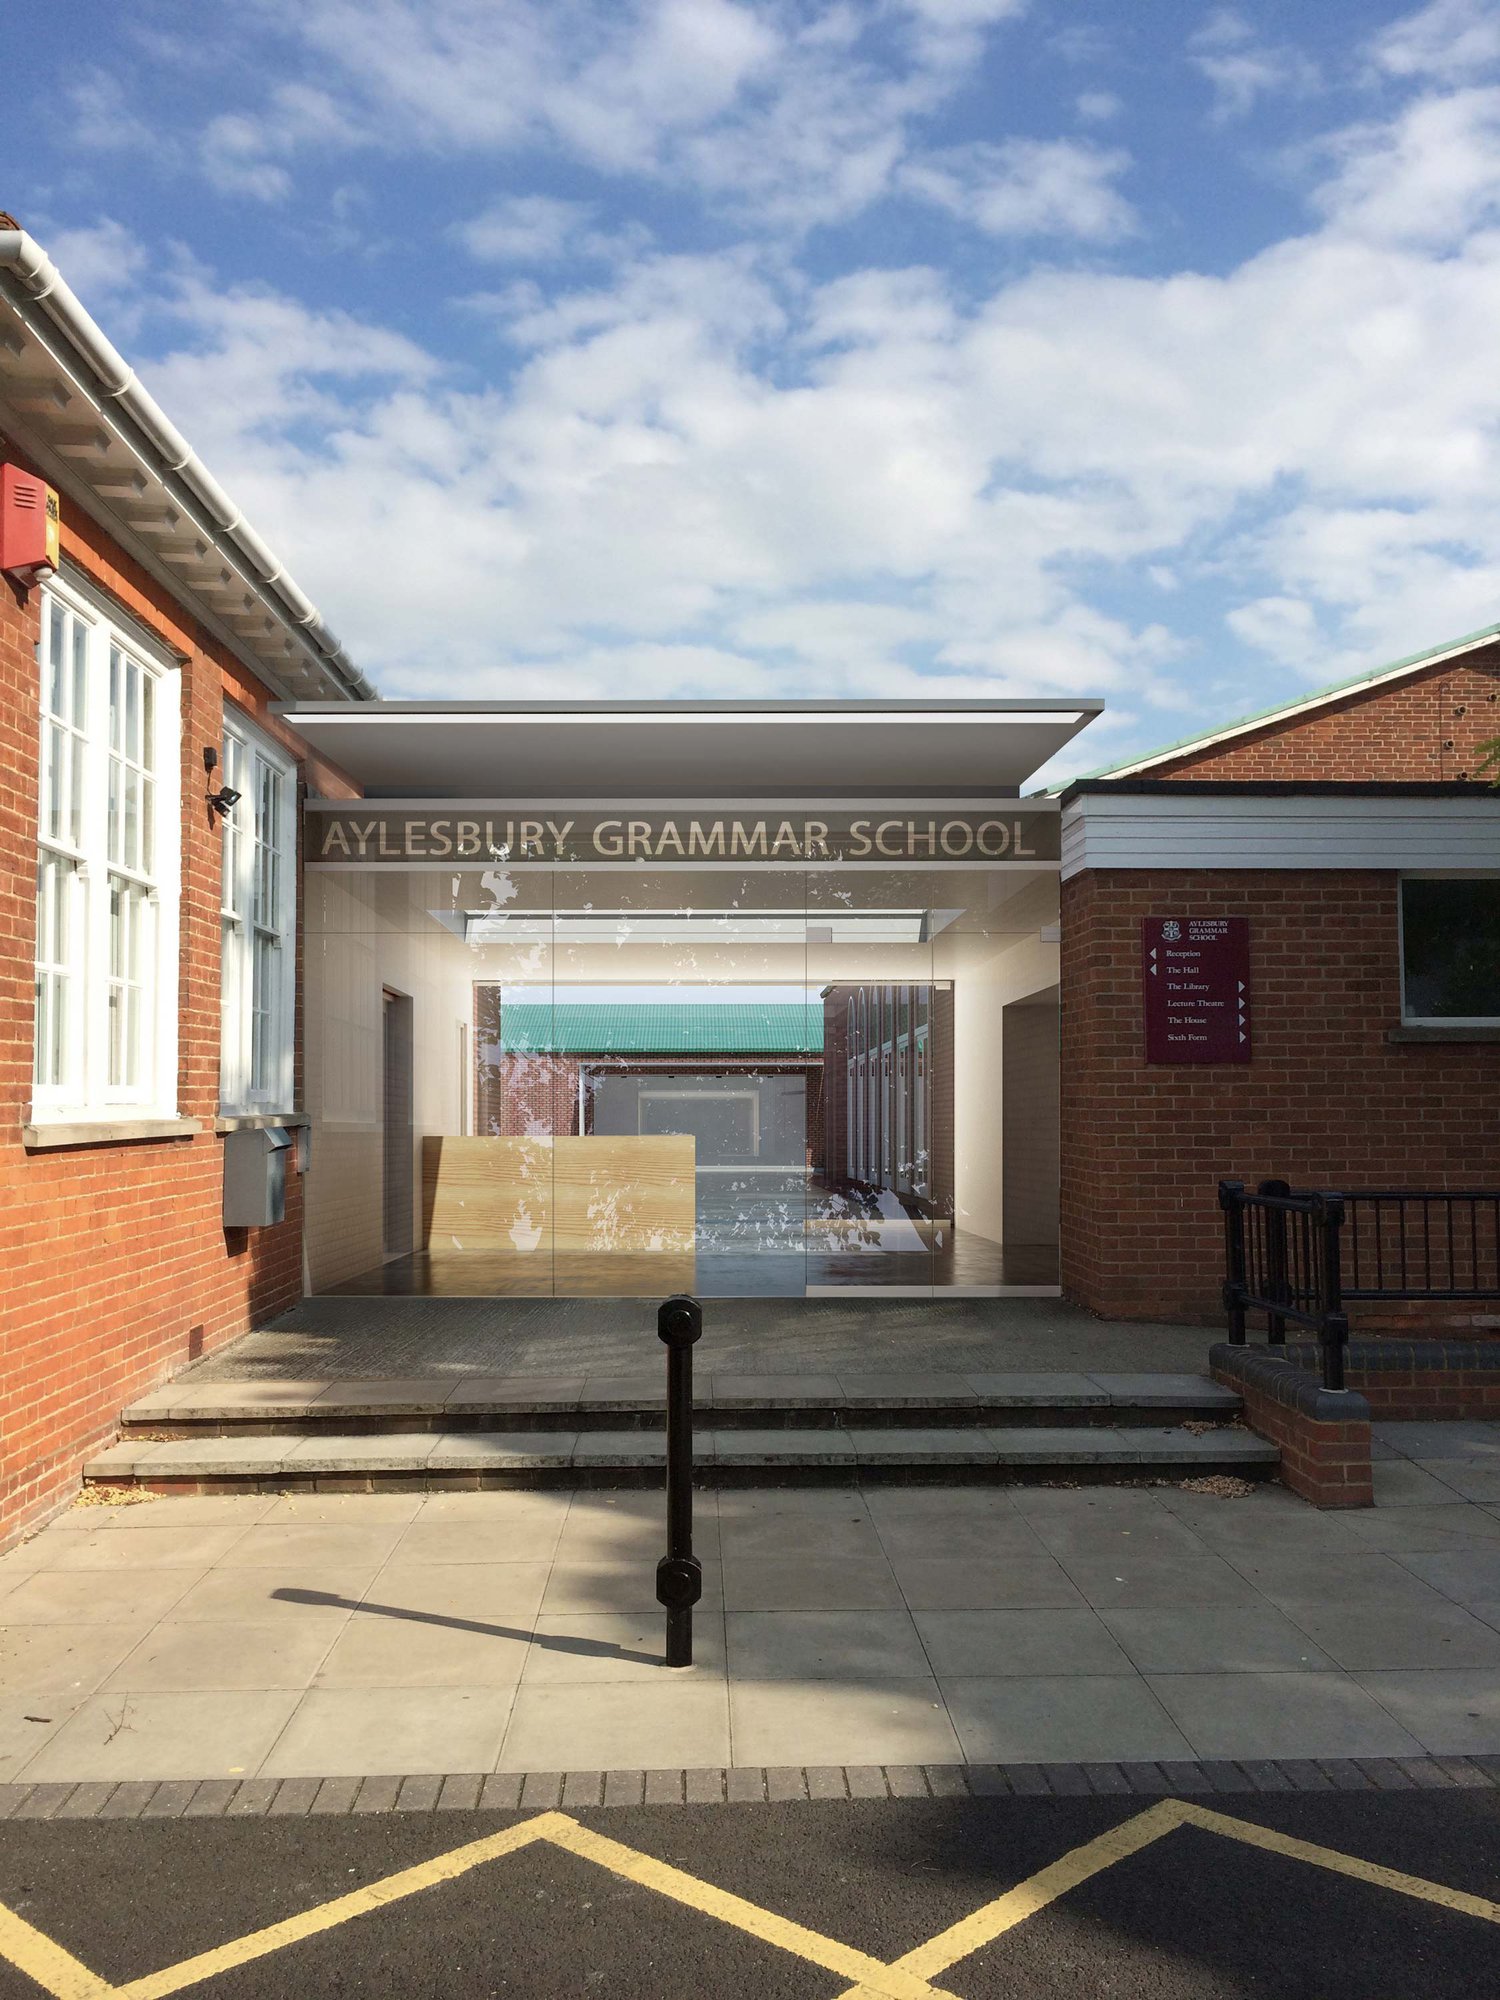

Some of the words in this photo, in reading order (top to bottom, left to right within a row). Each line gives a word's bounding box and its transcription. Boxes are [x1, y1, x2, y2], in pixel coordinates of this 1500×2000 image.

[320, 820, 575, 856] AYLESBURY
[592, 820, 830, 856] GRAMMAR
[849, 820, 1036, 856] SCHOOL
[1166, 950, 1201, 959] Reception
[1166, 982, 1181, 990] The
[1183, 982, 1210, 991] Library
[1168, 1016, 1182, 1024] The
[1184, 1016, 1207, 1024] House
